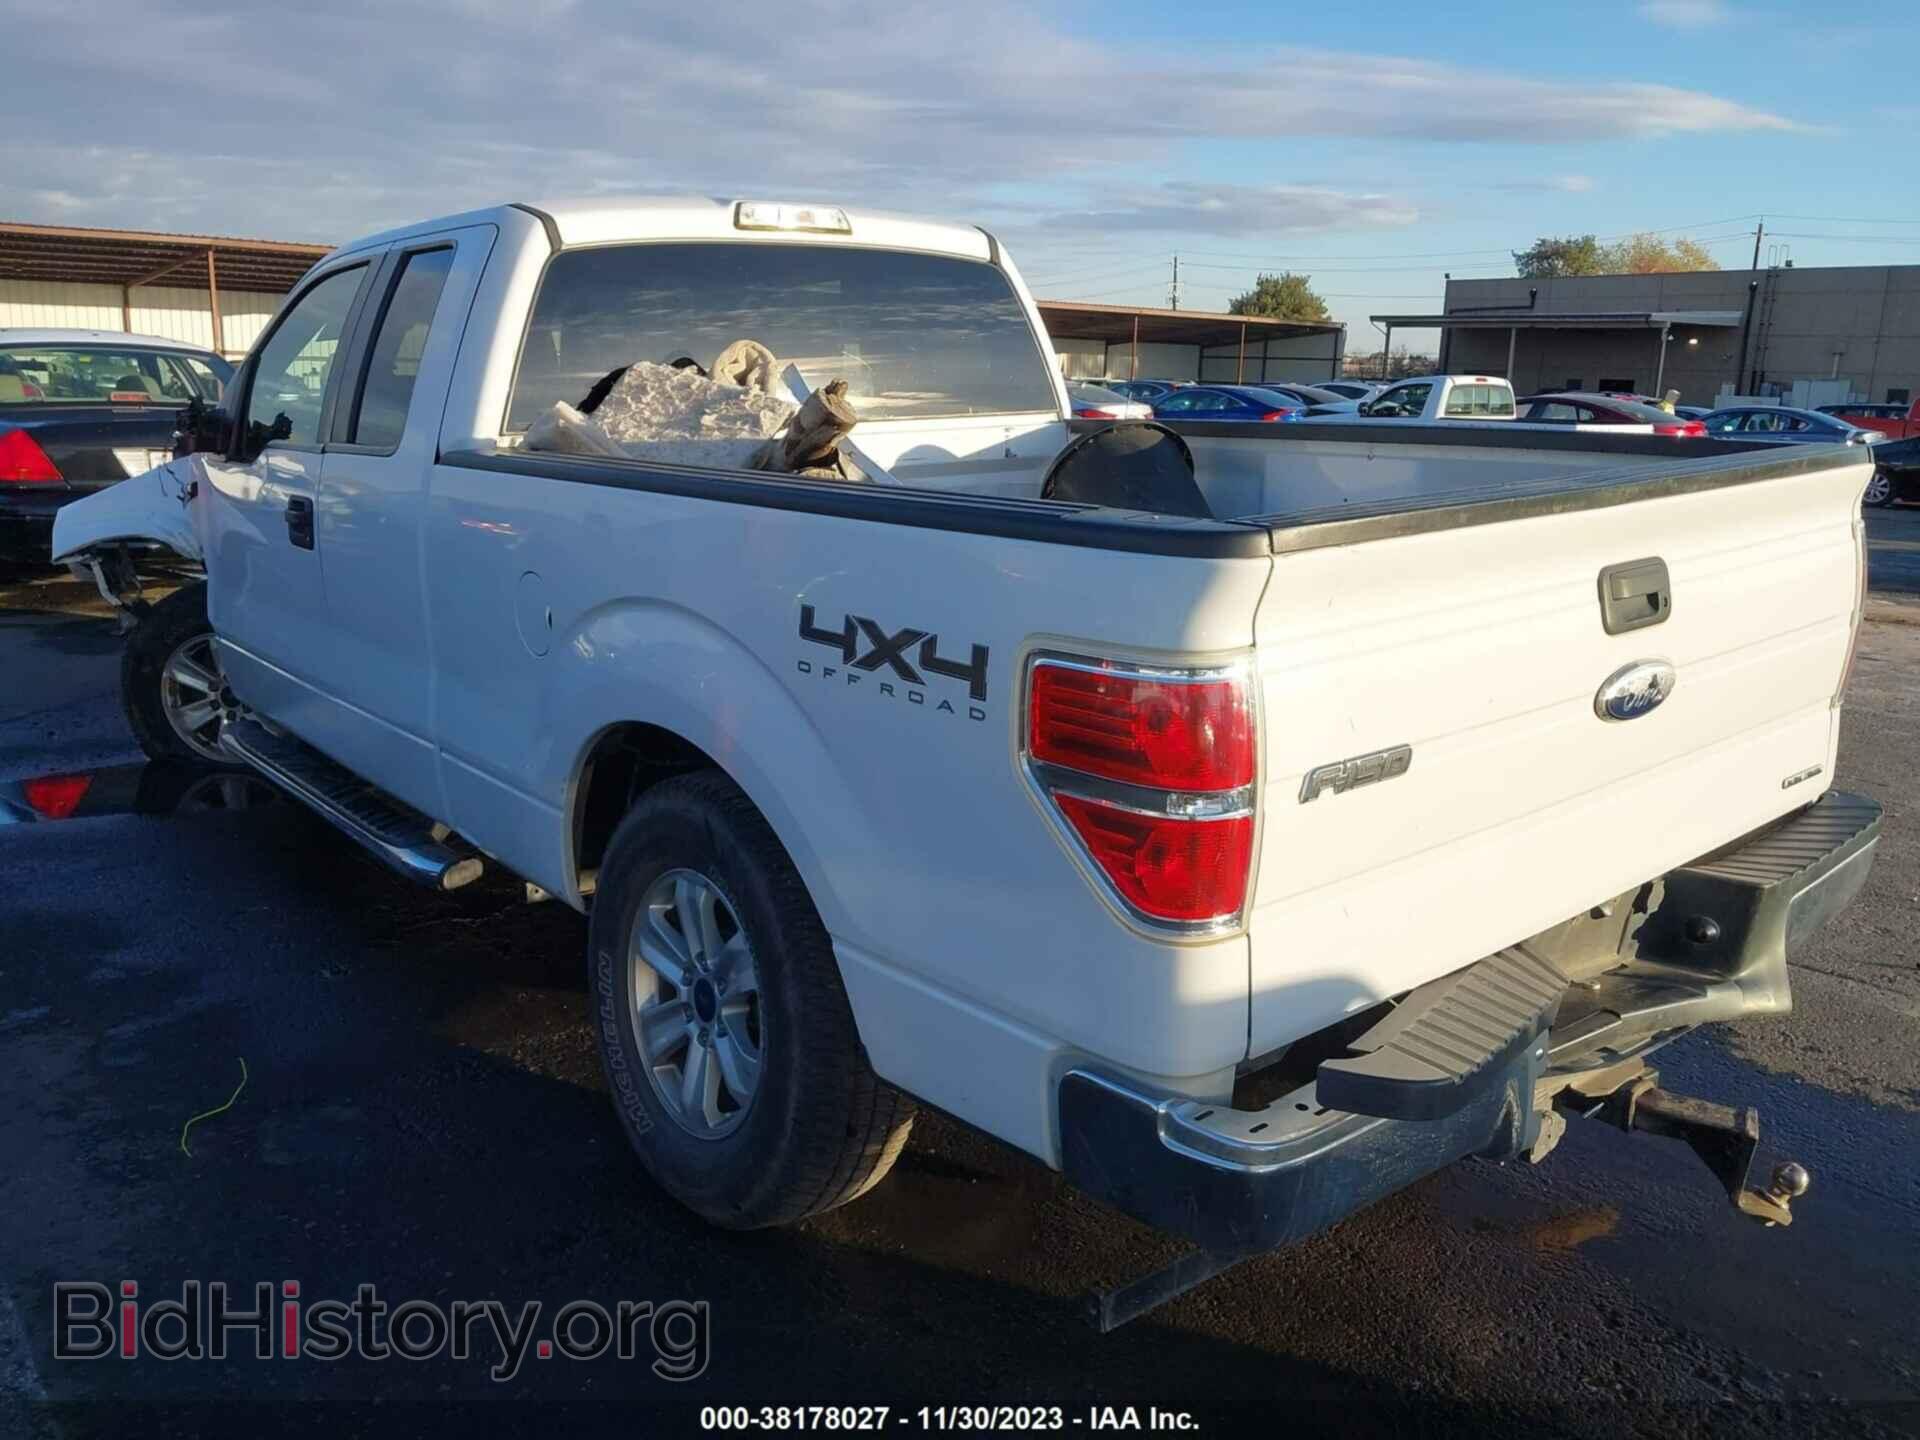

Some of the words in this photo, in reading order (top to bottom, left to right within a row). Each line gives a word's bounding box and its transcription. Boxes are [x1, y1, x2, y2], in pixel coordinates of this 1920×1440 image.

[797, 660, 861, 686] OFF
[879, 682, 986, 722] ROAD
[597, 950, 655, 1136] MICHELIN
